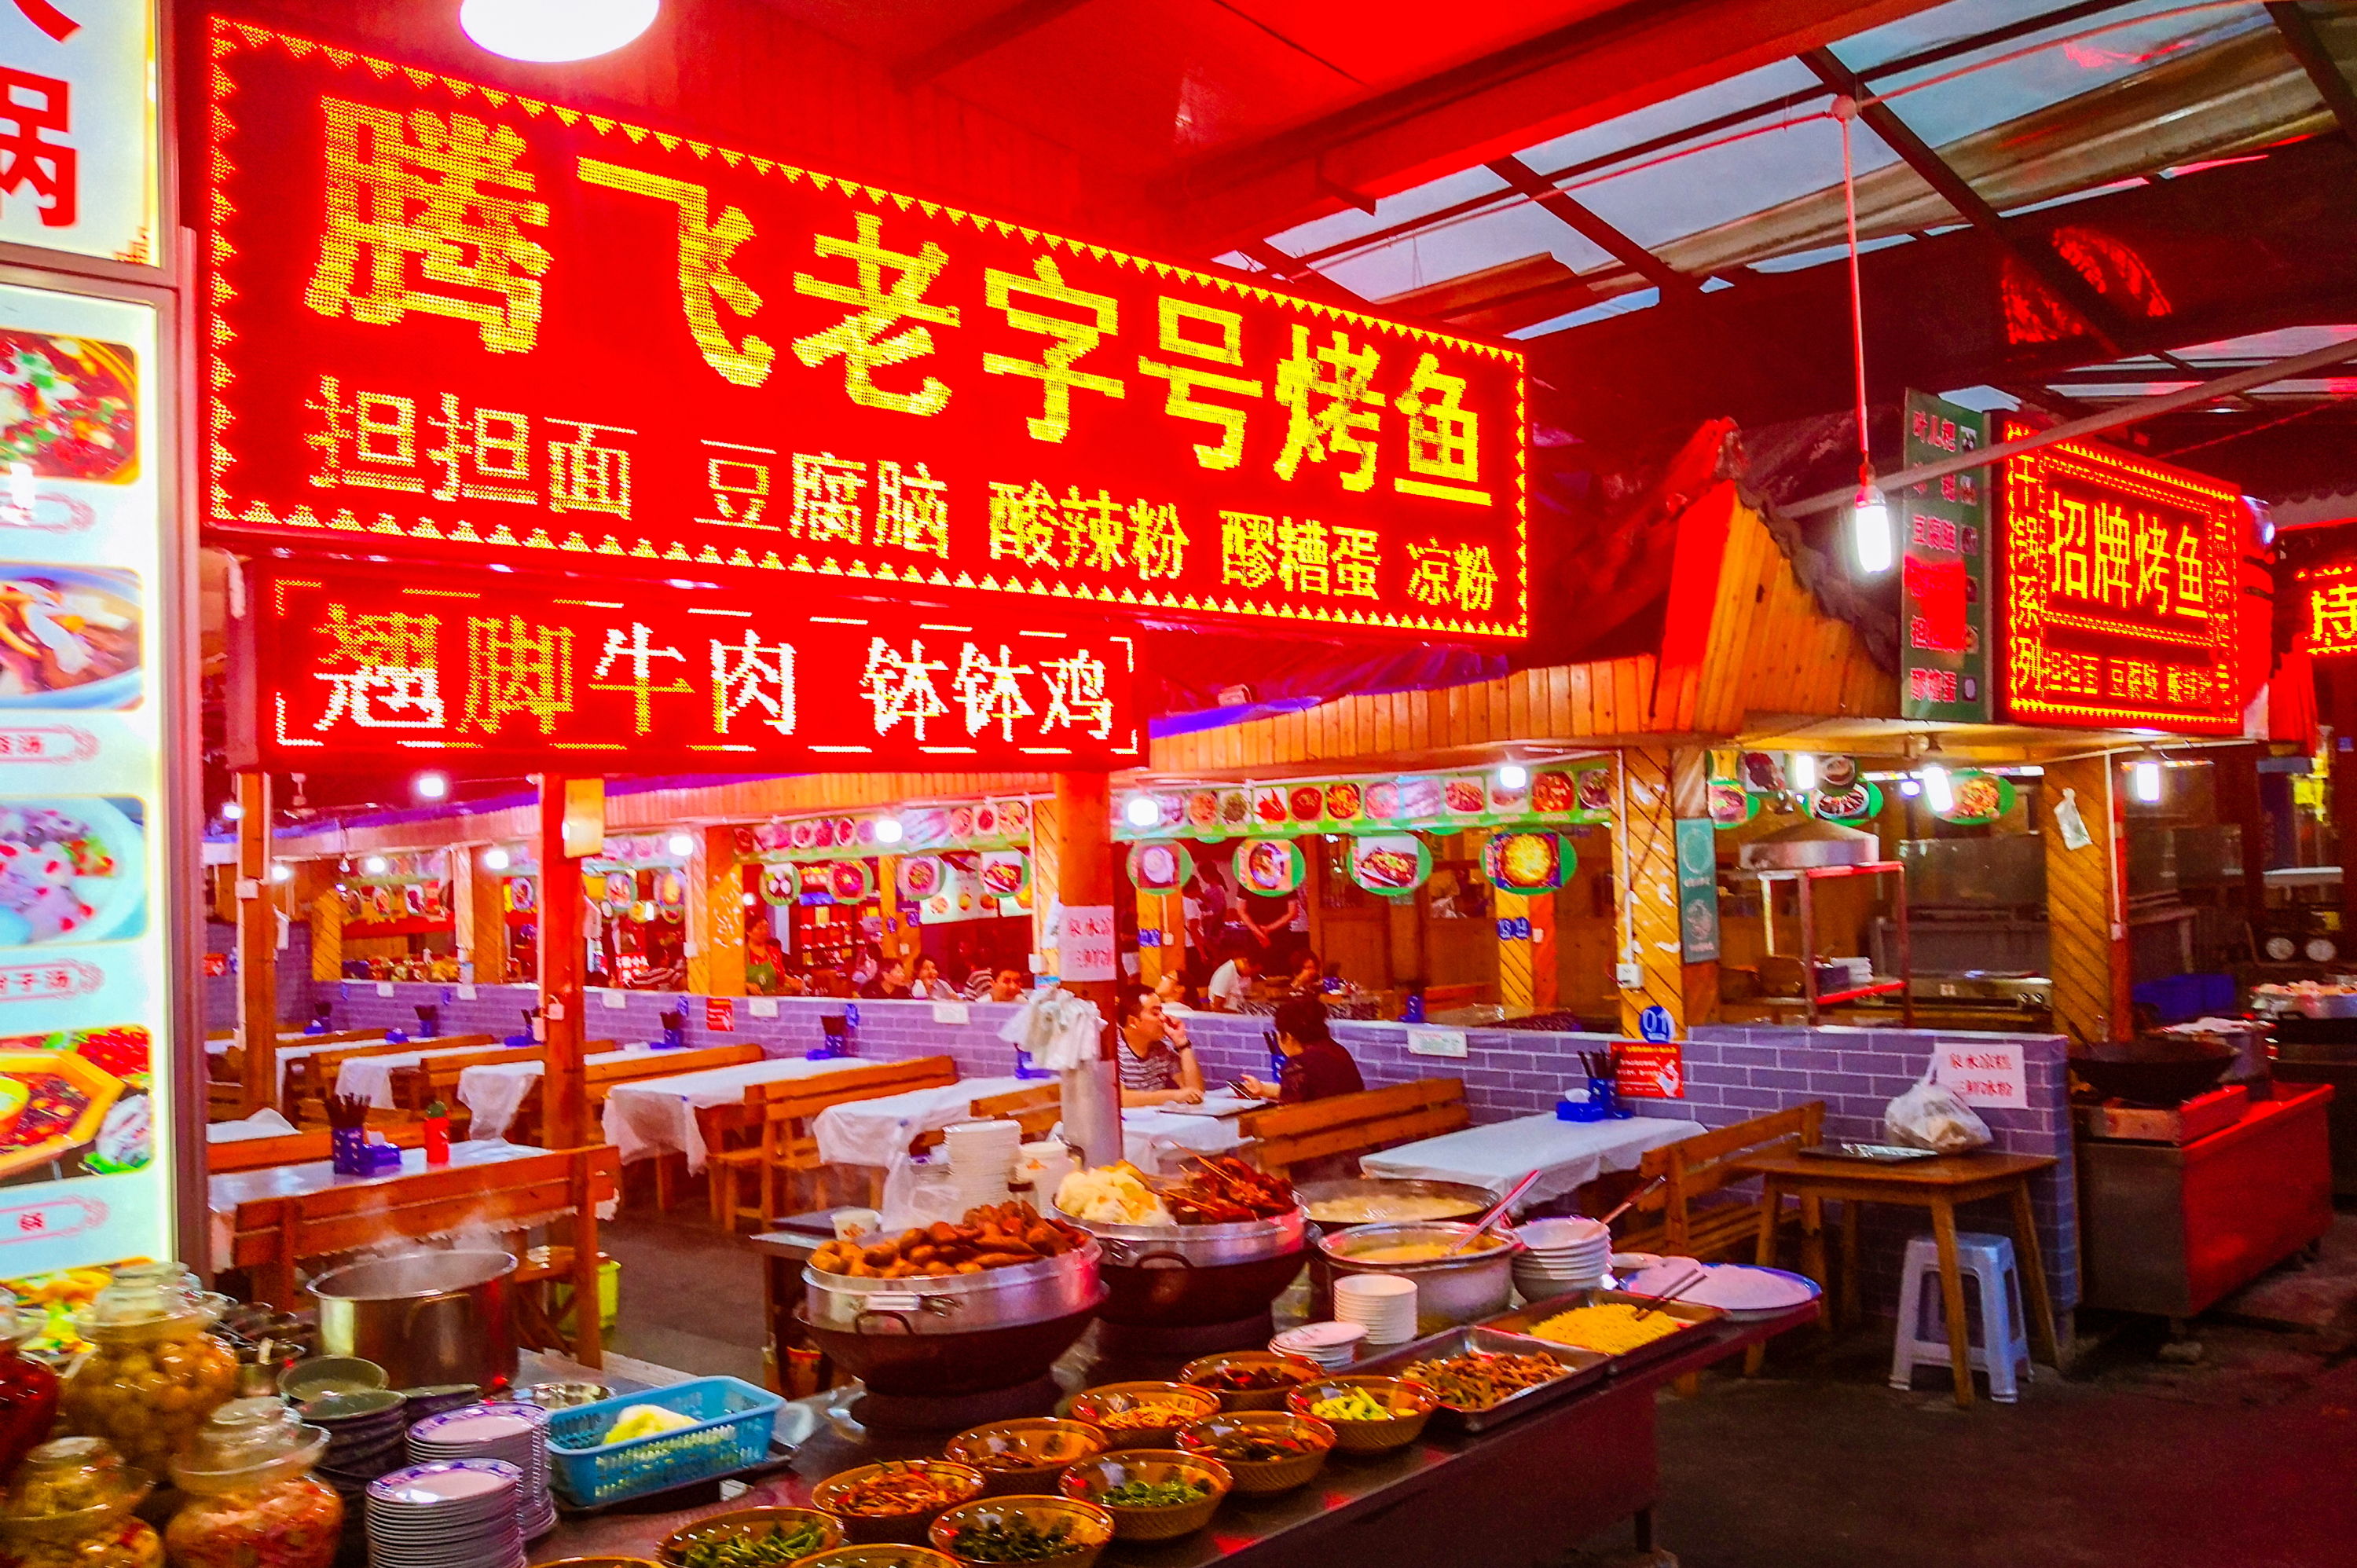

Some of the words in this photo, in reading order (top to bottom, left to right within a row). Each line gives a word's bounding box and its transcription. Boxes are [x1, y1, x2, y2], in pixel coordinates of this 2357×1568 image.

[304, 94, 1492, 506] 腾飞老字号烤鱼
[305, 375, 638, 521] 担担面
[693, 439, 950, 559] 豆腐脑
[988, 480, 1190, 581] 酸辣粉
[1406, 537, 1499, 612] 凉粉
[2047, 490, 2209, 619] 招牌烤鱼
[313, 603, 797, 737] 翘脚牛肉
[859, 637, 1115, 742] 钵钵鸡
